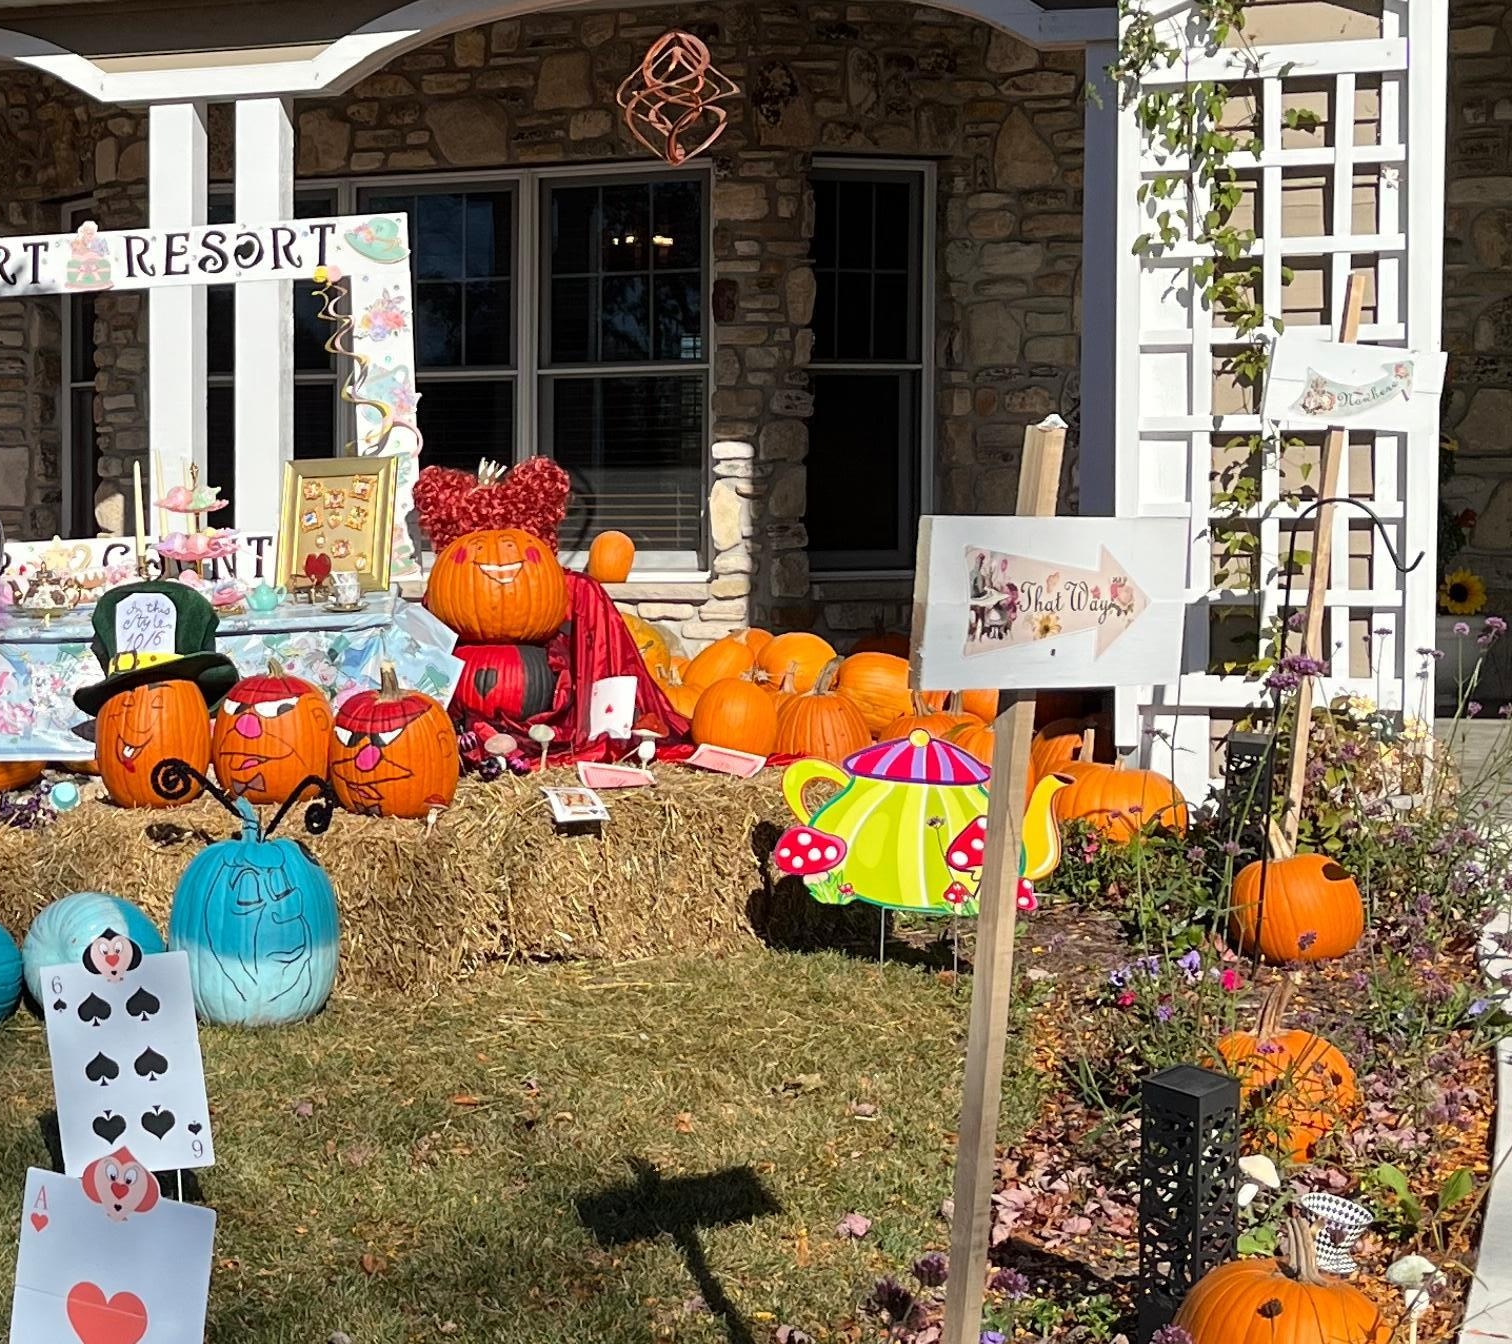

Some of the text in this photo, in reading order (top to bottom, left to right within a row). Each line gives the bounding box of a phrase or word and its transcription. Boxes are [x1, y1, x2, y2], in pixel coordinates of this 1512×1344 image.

[123, 223, 336, 278] RESORT
[126, 600, 171, 617] In this
[1017, 580, 1111, 625] That Way
[125, 630, 166, 651] 10/6
[51, 975, 63, 995] 6
[33, 1185, 48, 1211] A
